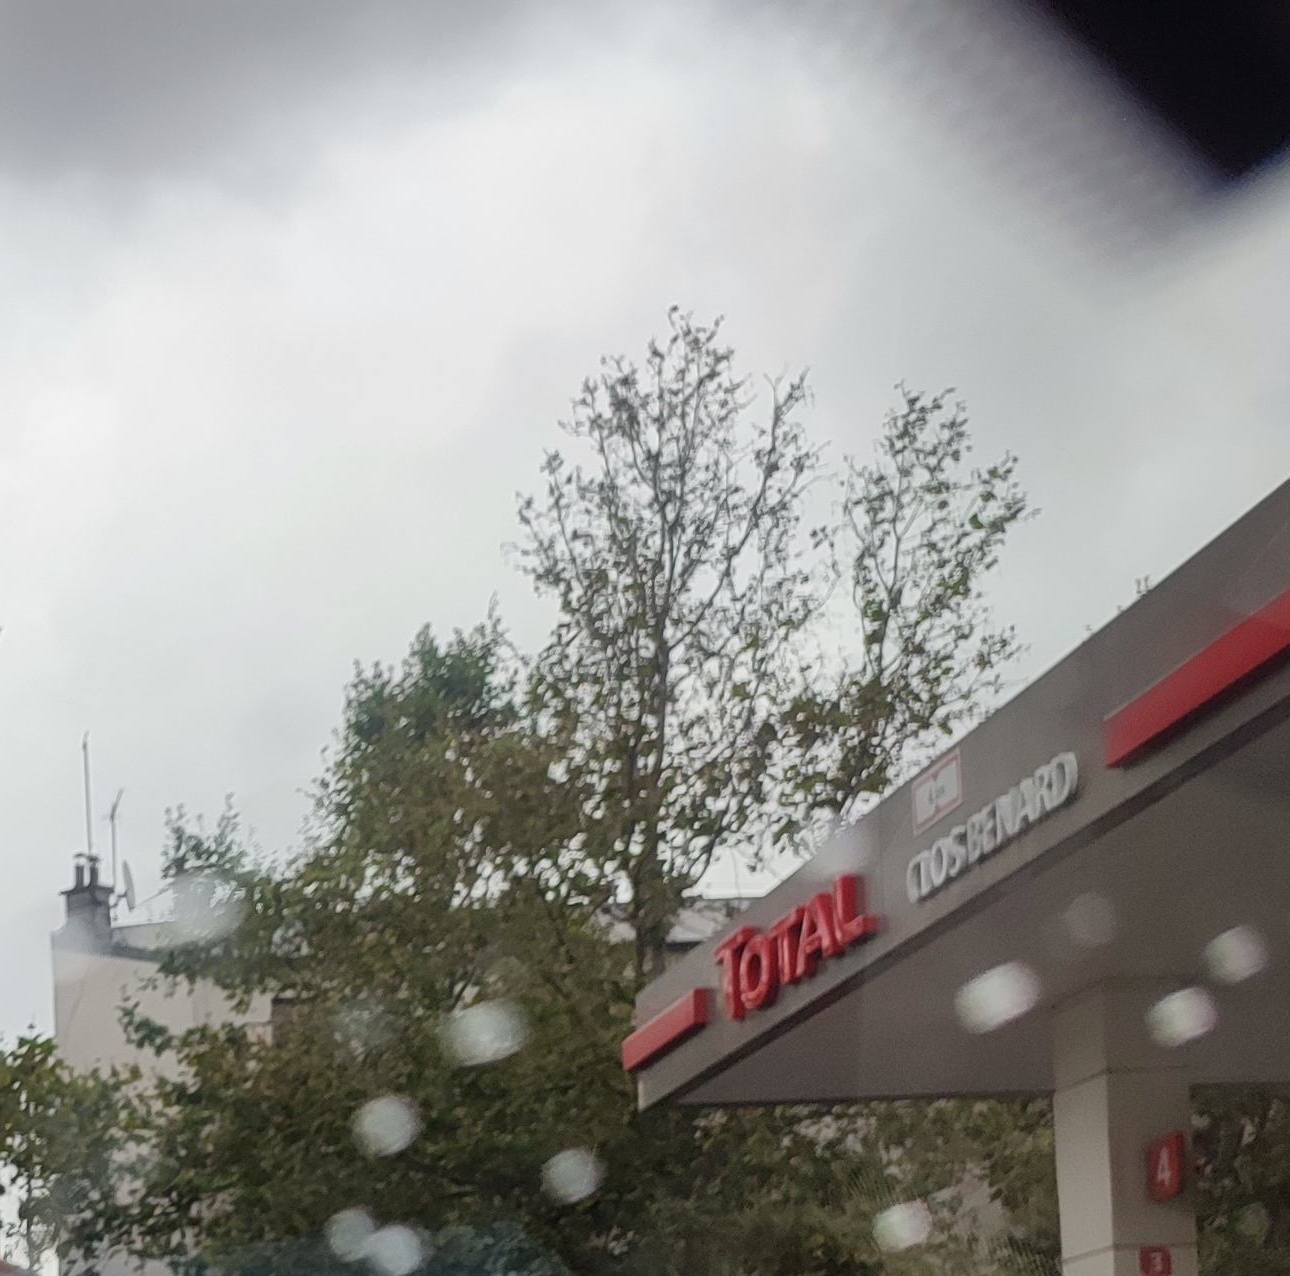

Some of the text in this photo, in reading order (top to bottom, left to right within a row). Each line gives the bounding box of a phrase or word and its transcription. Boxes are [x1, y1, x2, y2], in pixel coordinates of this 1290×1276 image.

[907, 823, 968, 903] CLOS
[716, 873, 879, 1020] TOTAL
[1157, 1147, 1172, 1187] 4
